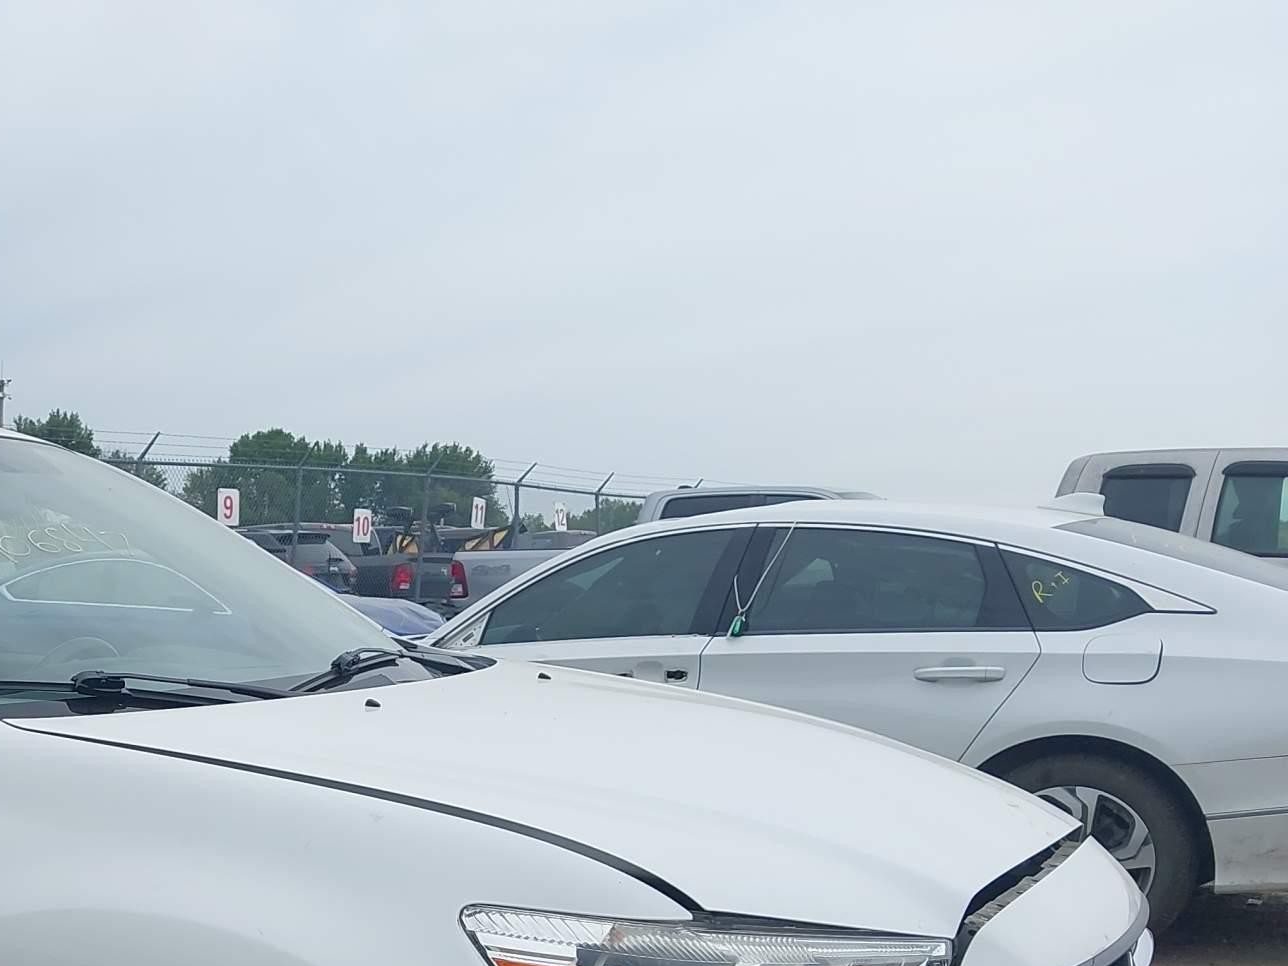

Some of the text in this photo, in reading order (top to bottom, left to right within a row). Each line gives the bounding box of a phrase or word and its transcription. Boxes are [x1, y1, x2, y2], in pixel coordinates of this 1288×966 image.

[223, 495, 234, 519] 9
[474, 503, 485, 526] 11
[555, 508, 566, 527] 12
[355, 516, 370, 537] 10
